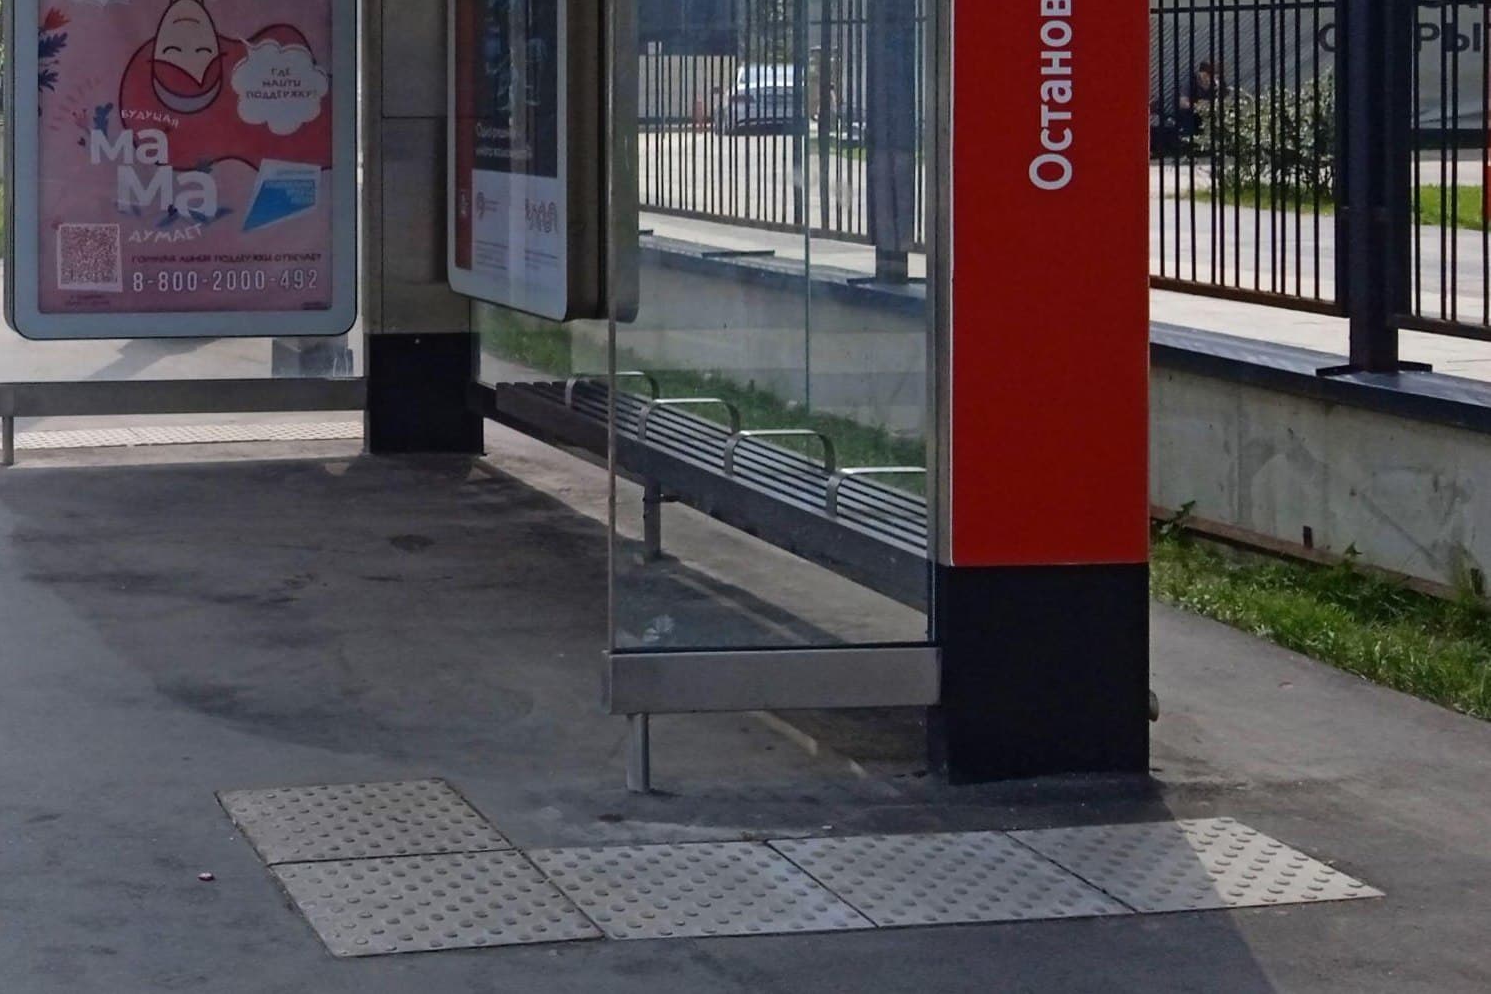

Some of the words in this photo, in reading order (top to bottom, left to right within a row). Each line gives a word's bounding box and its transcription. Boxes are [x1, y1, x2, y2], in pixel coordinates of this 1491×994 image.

[120, 109, 180, 128] БУДУЩАЯ
[128, 223, 203, 243] ДУМАЕТ
[132, 269, 319, 292] 8-800-2000-492
